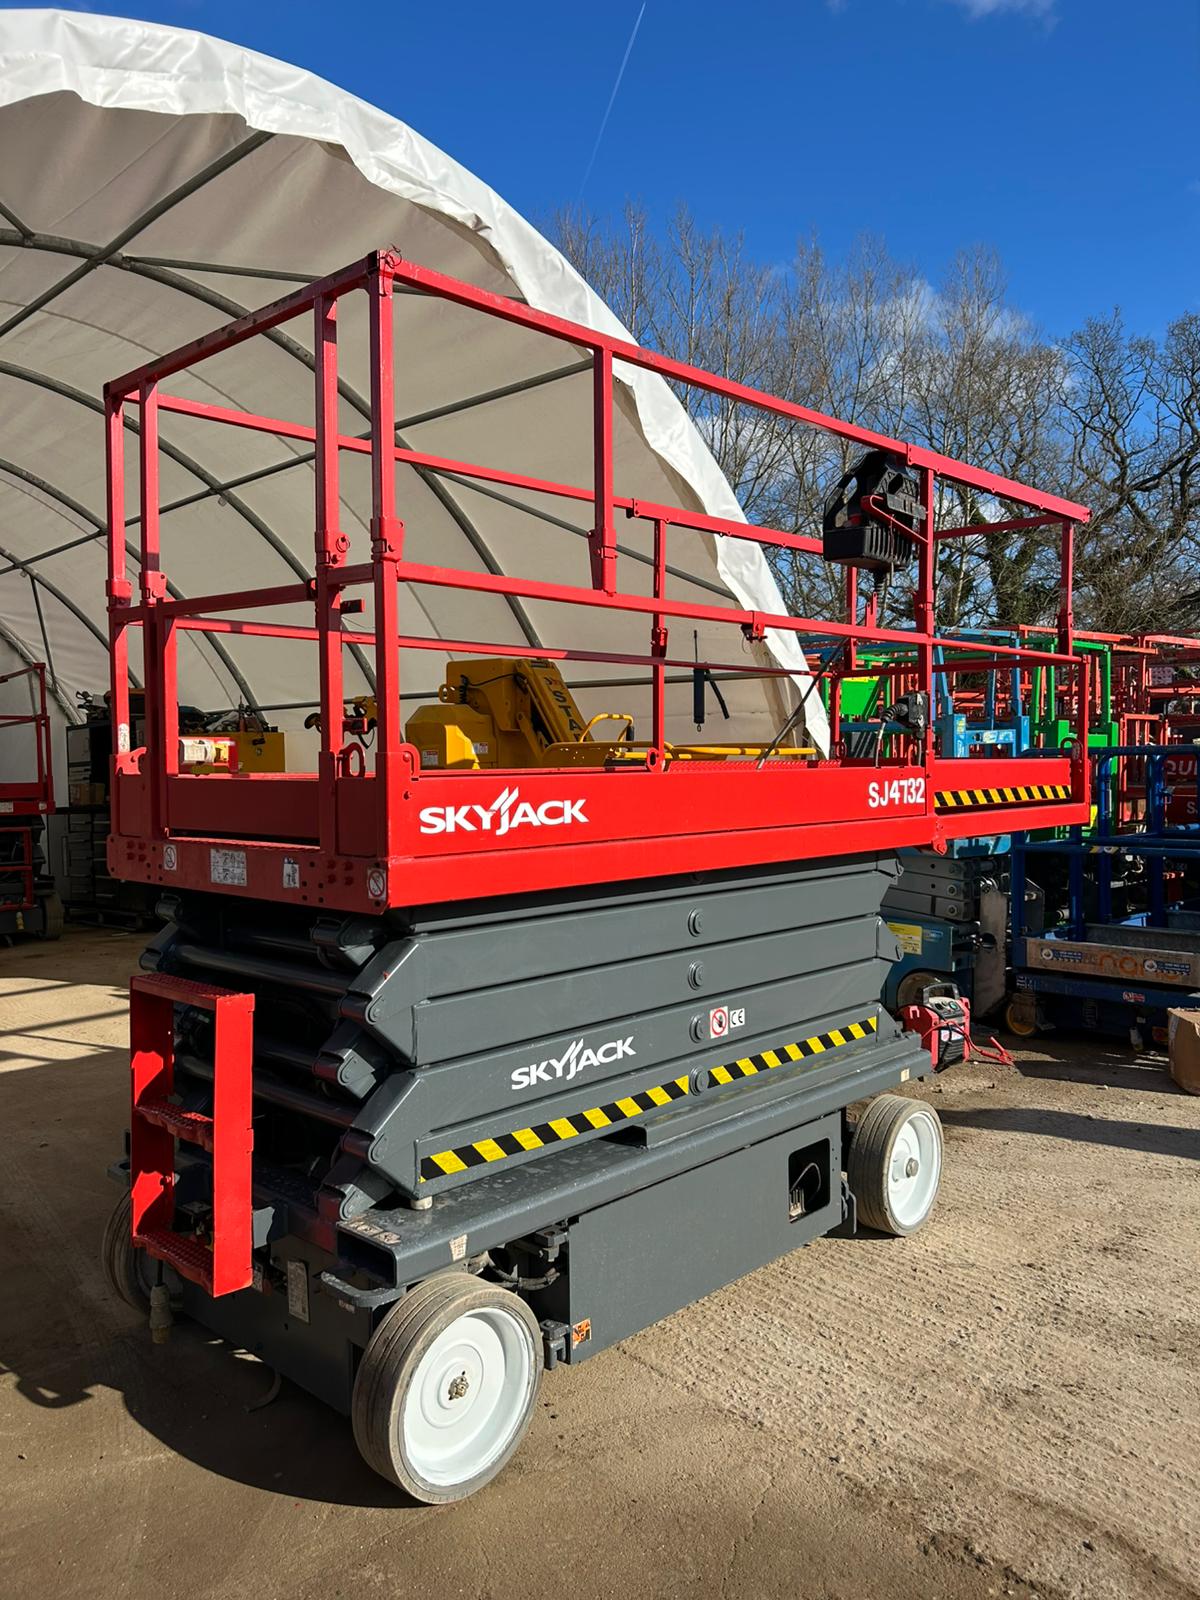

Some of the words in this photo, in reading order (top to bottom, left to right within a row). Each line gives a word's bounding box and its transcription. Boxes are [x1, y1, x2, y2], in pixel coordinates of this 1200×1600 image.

[419, 786, 589, 836] SKYJACK
[868, 777, 926, 808] SJ4732
[511, 1036, 637, 1090] SKYJACK
